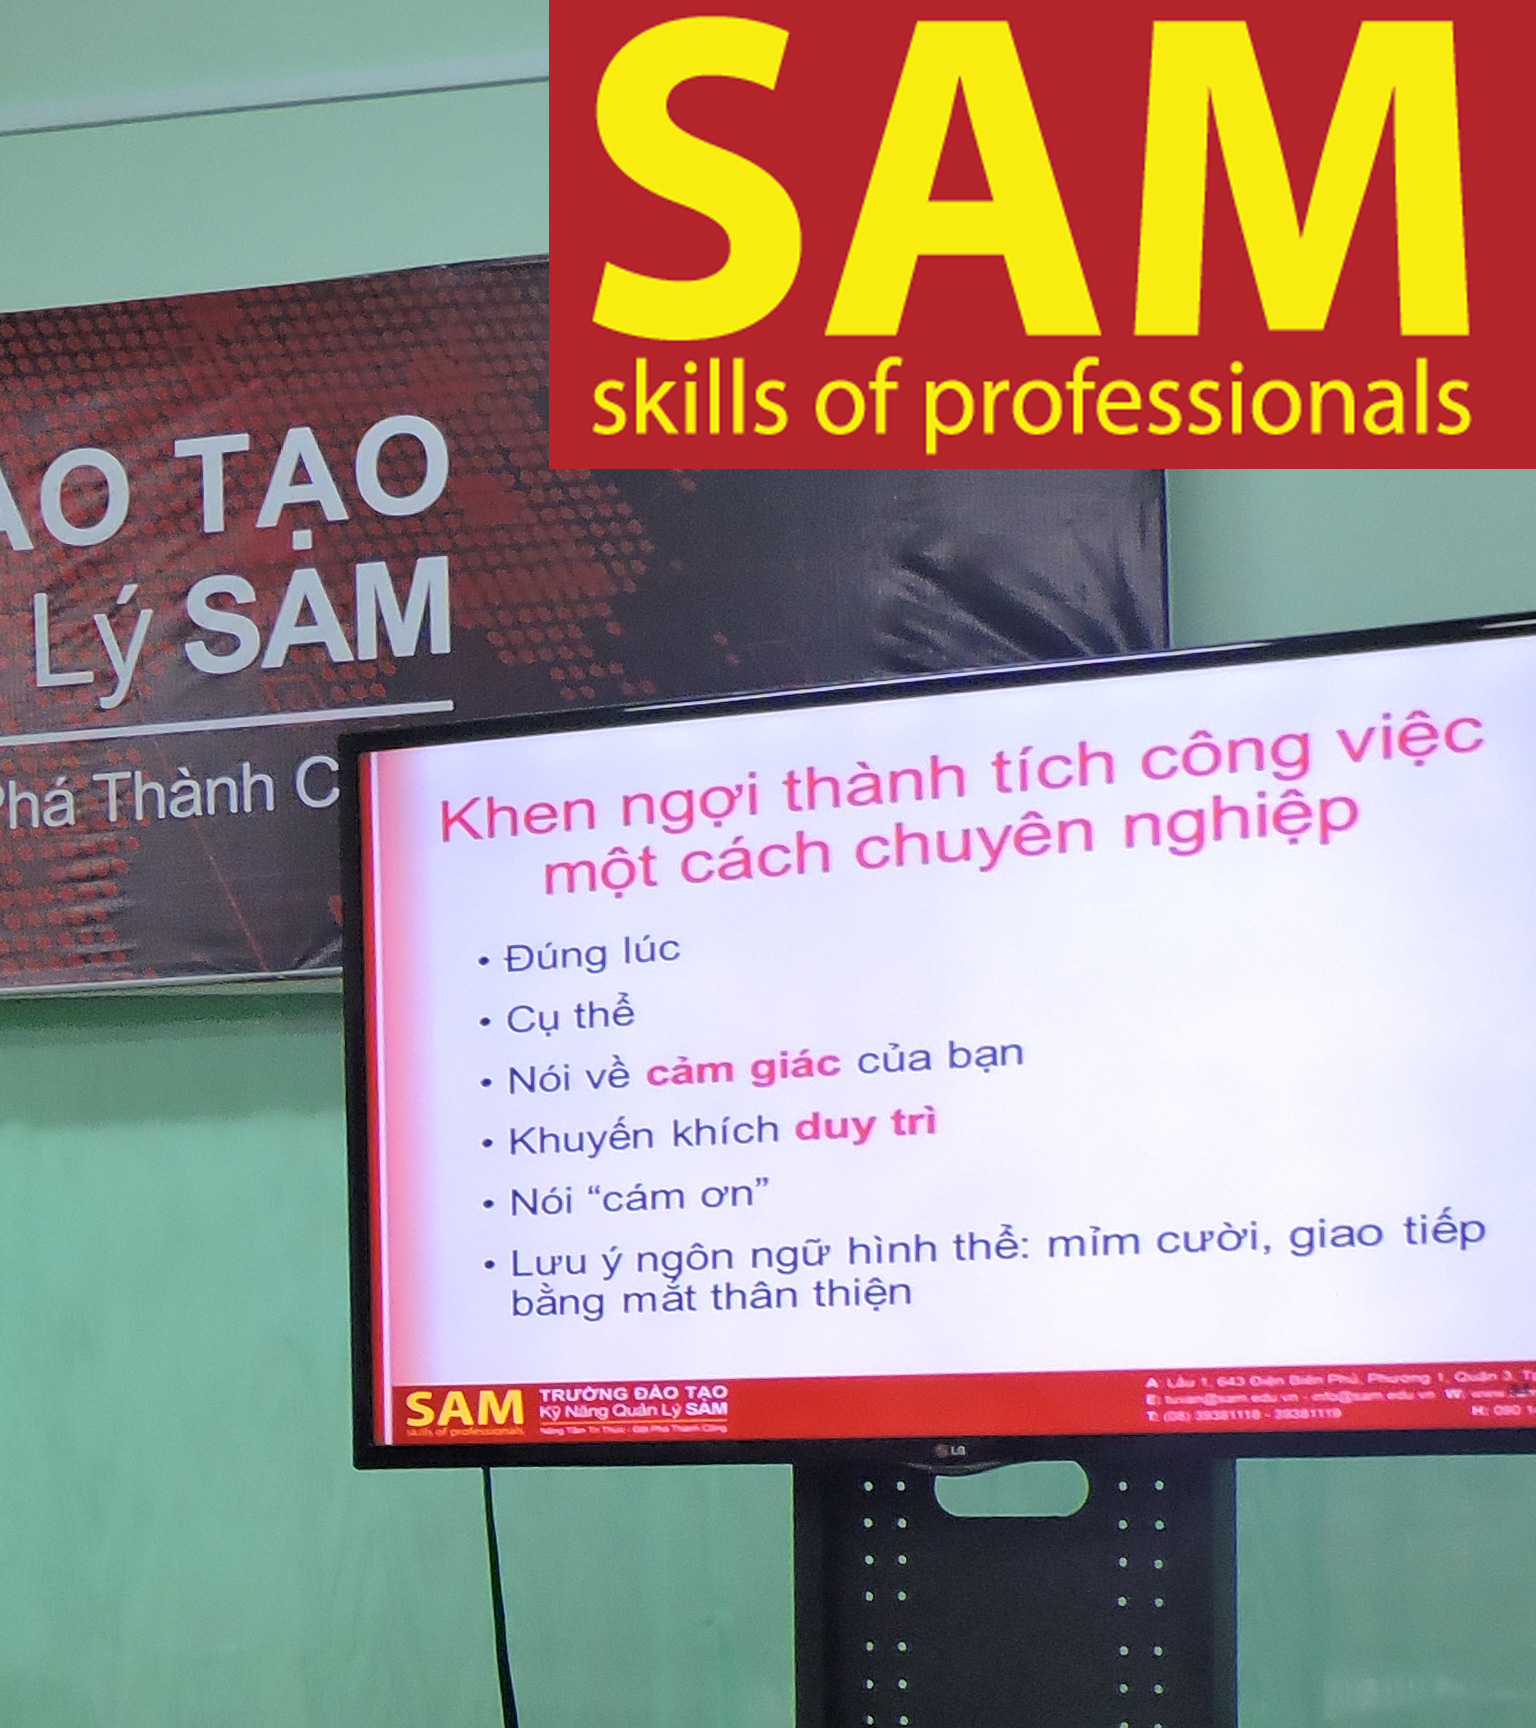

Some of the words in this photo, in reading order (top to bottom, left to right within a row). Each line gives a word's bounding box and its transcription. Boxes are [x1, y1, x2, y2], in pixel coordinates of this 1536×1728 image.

[175, 415, 448, 550] TẠO
[34, 584, 153, 708] Lý
[185, 556, 450, 674] SAM
[93, 762, 274, 822] Thành
[442, 796, 595, 842] Khen
[623, 772, 757, 834] ngợi
[782, 755, 964, 811] thành
[992, 741, 1114, 793] tích
[1142, 730, 1309, 781] công
[1337, 710, 1483, 766] việc
[546, 846, 657, 898] một
[681, 831, 829, 883] cách
[856, 811, 1092, 872] chuyên
[1126, 789, 1358, 856] nghiệp
[504, 942, 606, 973] Đúng
[625, 935, 680, 963] lúc
[508, 1005, 558, 1036] Cụ
[574, 992, 634, 1028] thể
[510, 1064, 569, 1094] Nói
[586, 1055, 629, 1089] về
[647, 1056, 733, 1086] cảm
[751, 1049, 840, 1087] giác
[858, 1043, 931, 1073] của
[949, 1041, 1022, 1072] bạn
[511, 1116, 653, 1158] Khuyến
[674, 1115, 778, 1146] khích
[796, 1112, 876, 1145] duy
[891, 1106, 935, 1135] trì
[512, 1187, 571, 1216] Nói
[513, 1250, 585, 1276] Lưu
[602, 1246, 622, 1280] ý
[638, 1243, 732, 1279] ngôn
[752, 1239, 830, 1274] ngữ
[849, 1234, 936, 1264] hình
[954, 1224, 1027, 1260] thể:
[1049, 1226, 1139, 1257] mỉm
[1158, 1221, 1270, 1254] cười,
[1290, 1219, 1383, 1256] giao
[1404, 1207, 1485, 1250] tiếp
[513, 1283, 603, 1321] bằng
[624, 1279, 696, 1313] mắt
[711, 1281, 797, 1310] thân
[813, 1278, 911, 1311] thiện
[406, 1389, 524, 1427] SAM
